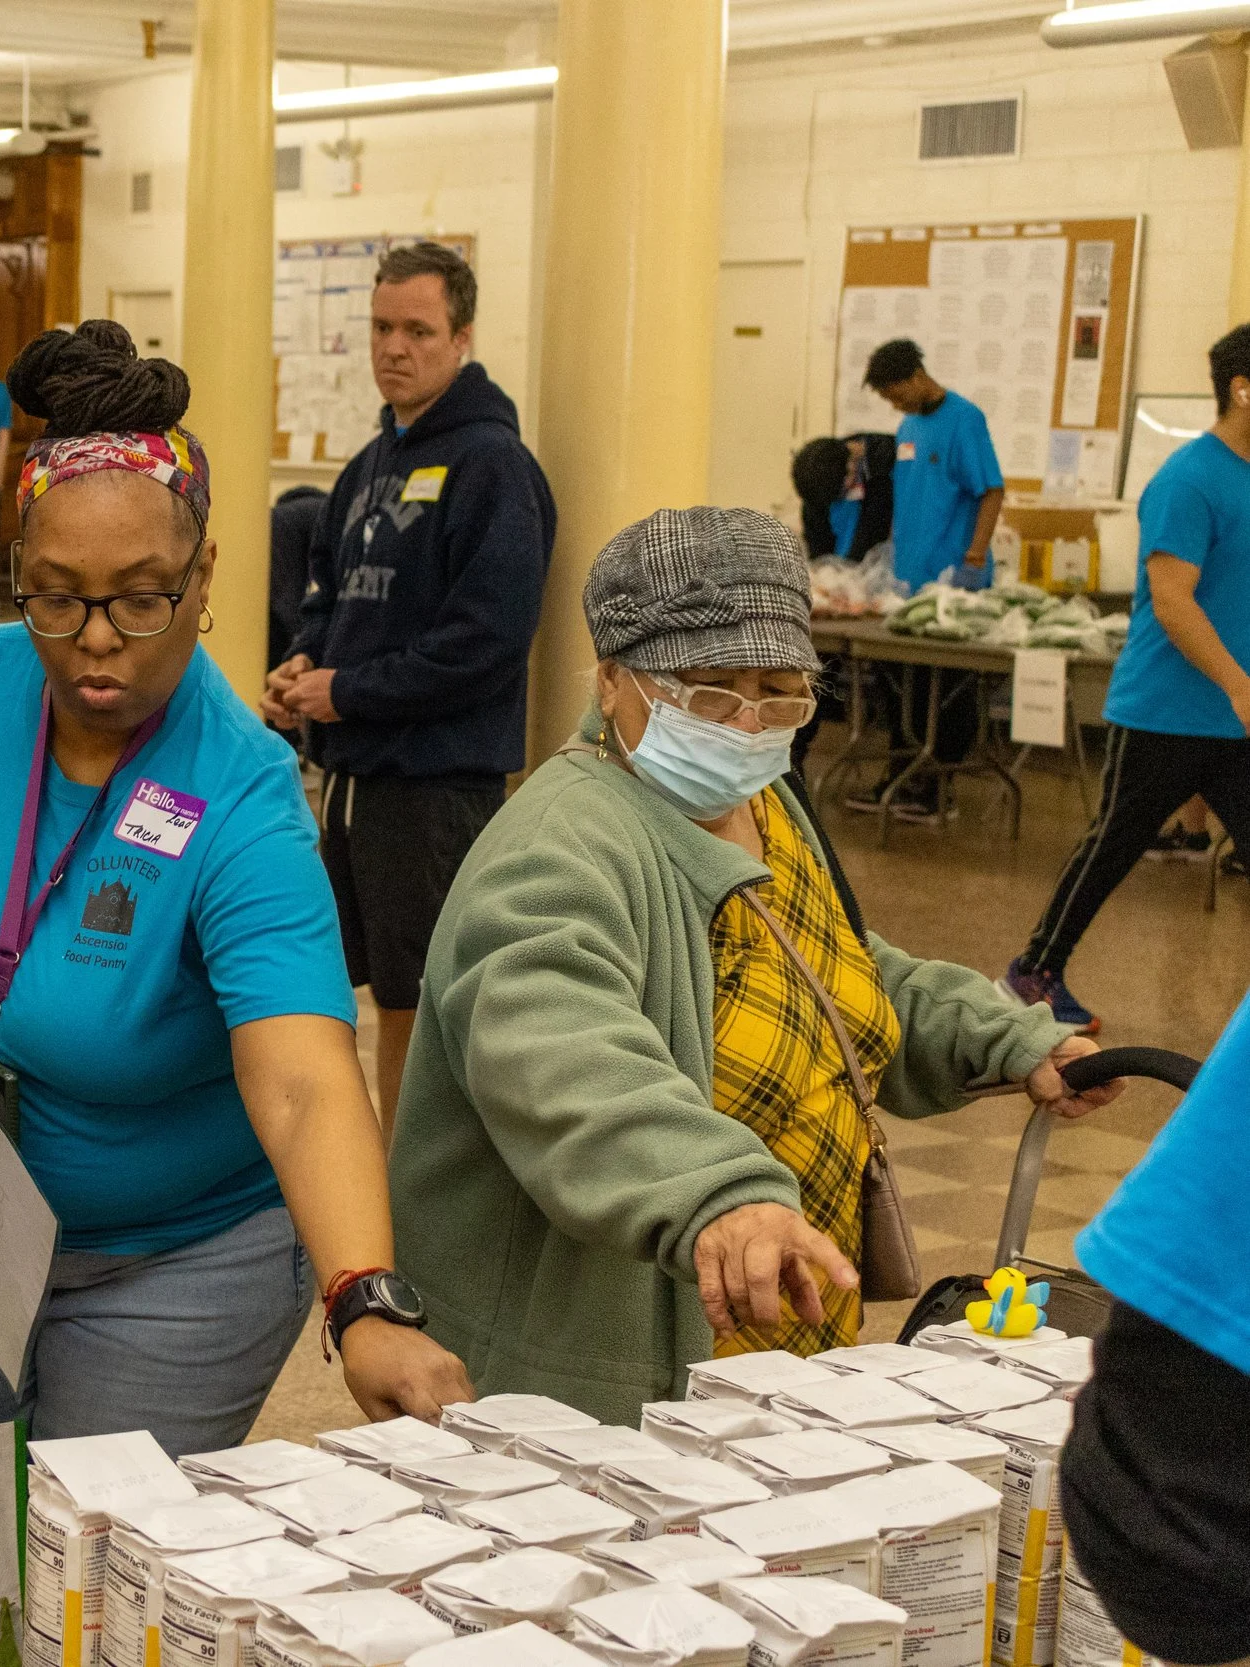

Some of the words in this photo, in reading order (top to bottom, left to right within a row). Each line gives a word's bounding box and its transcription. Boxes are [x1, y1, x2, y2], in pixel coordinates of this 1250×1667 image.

[137, 782, 175, 810] Hello
[124, 822, 162, 845] TRICIA
[86, 856, 161, 885] OLUNTEER
[64, 949, 93, 966] Food
[94, 956, 127, 972] Pantry
[1014, 1448, 1037, 1463] Facts
[1017, 1478, 1031, 1491] 90
[48, 1521, 66, 1537] Facts
[634, 1519, 646, 1529] cts
[667, 1526, 681, 1534] Corn
[681, 1524, 697, 1533] Meal
[53, 1556, 64, 1569] 90
[130, 1556, 150, 1572] Facts
[134, 1591, 146, 1605] 90
[194, 1607, 223, 1623] Facts
[454, 1619, 484, 1633] Facts
[200, 1643, 216, 1657] 90
[254, 1639, 282, 1659] utrition
[750, 1645, 774, 1662] Facts
